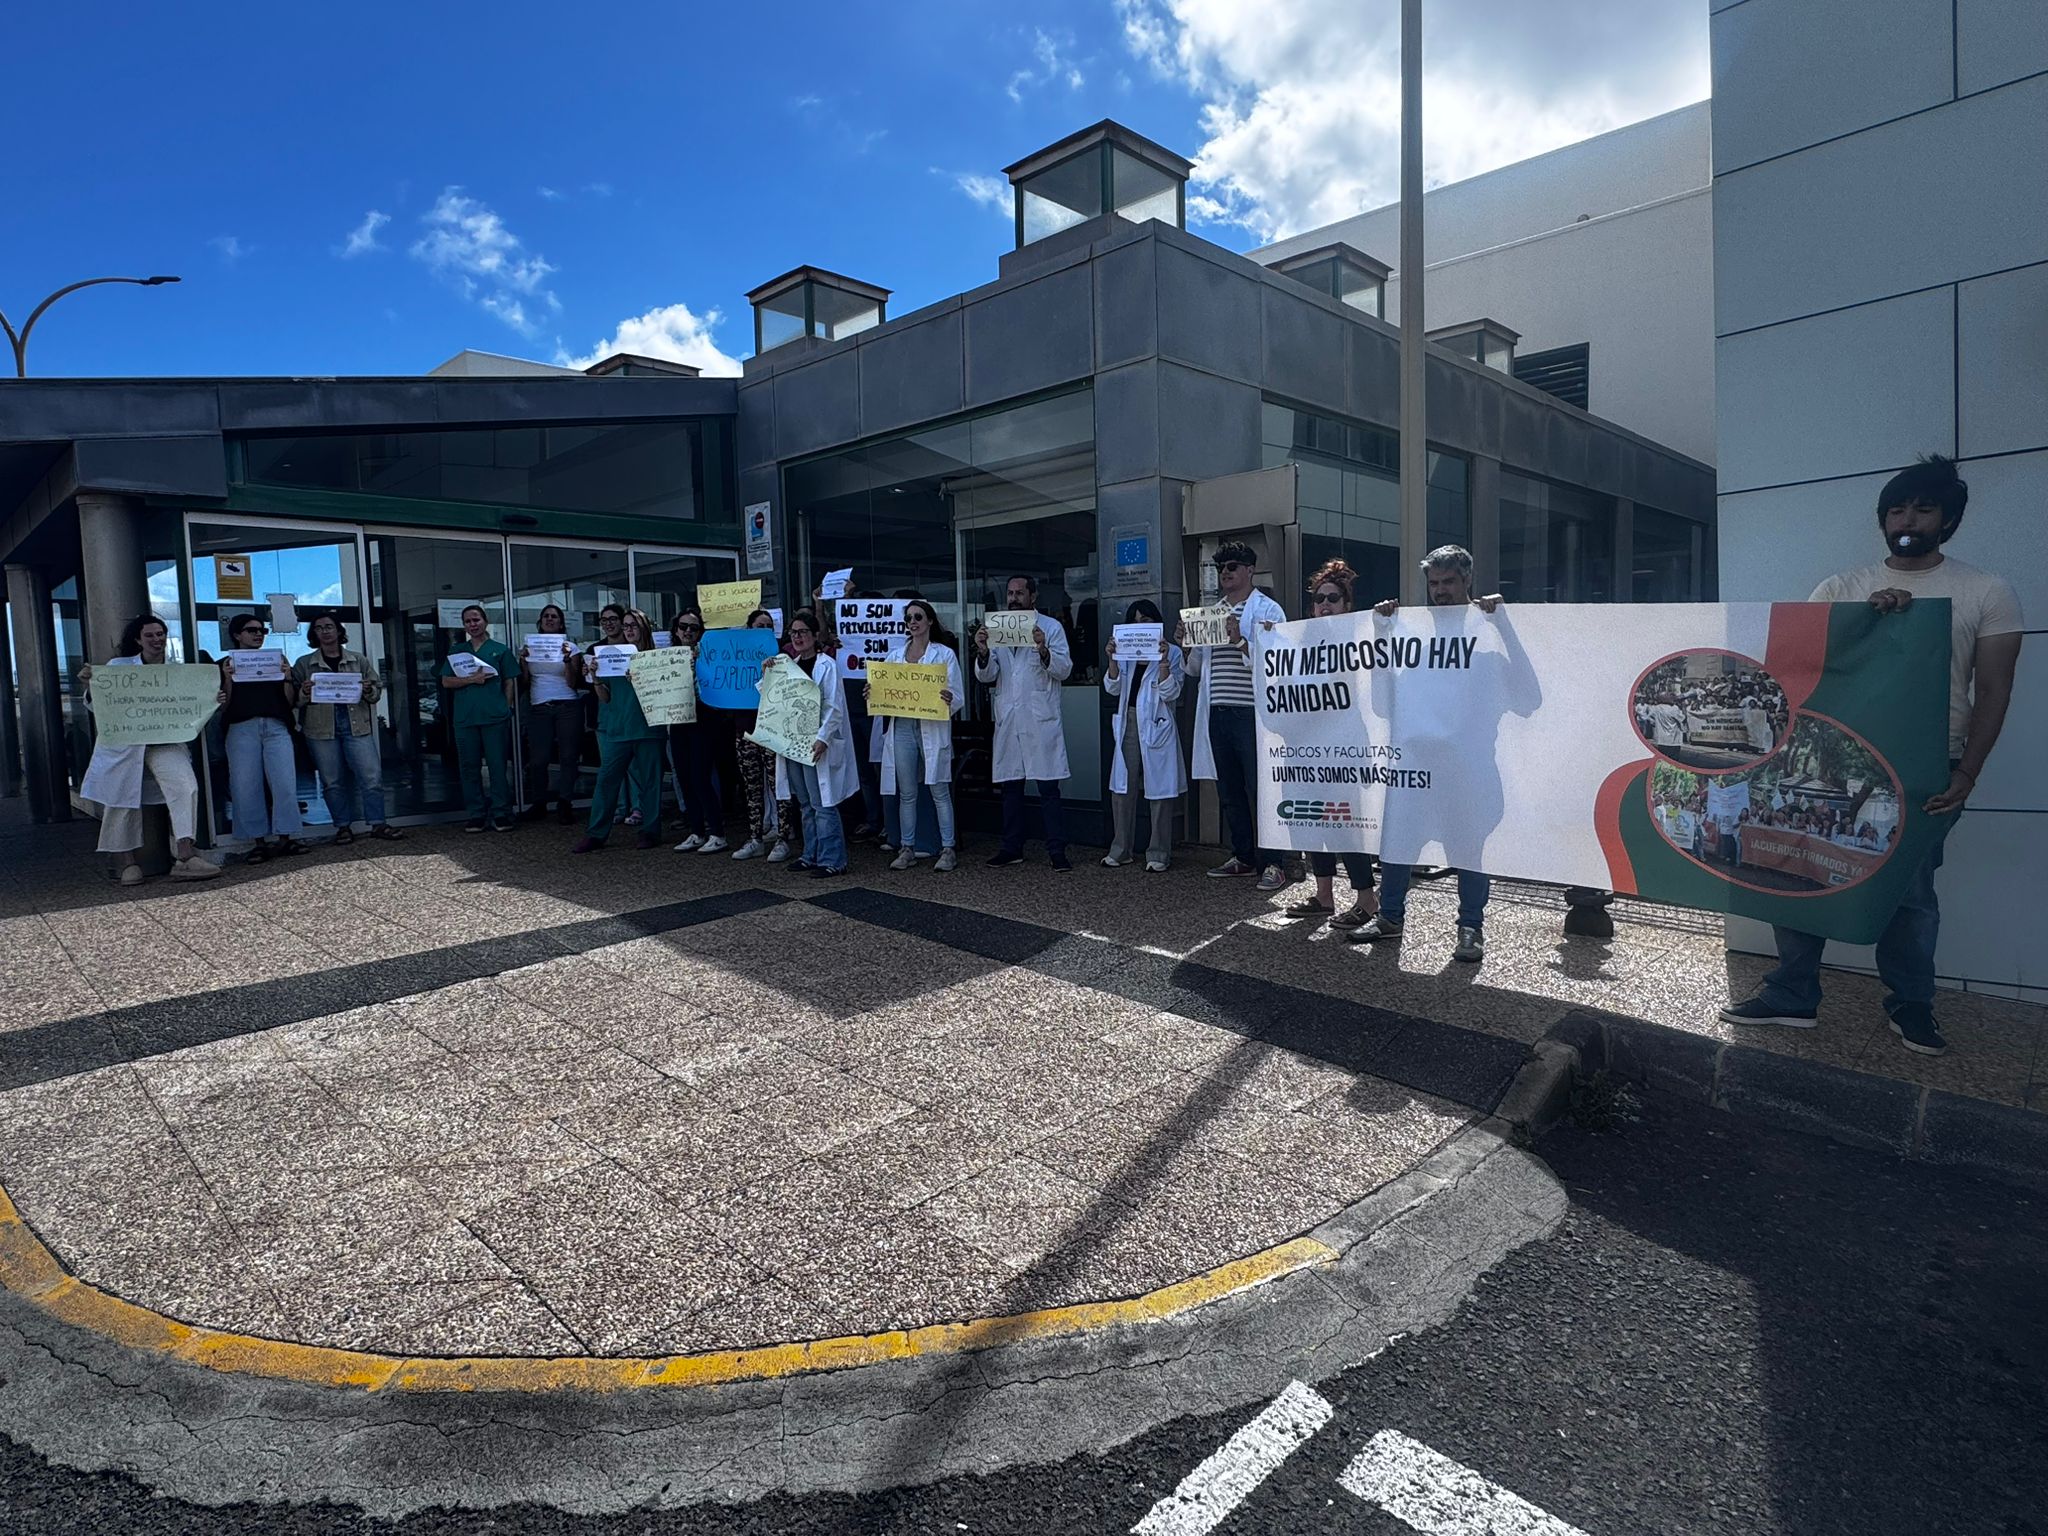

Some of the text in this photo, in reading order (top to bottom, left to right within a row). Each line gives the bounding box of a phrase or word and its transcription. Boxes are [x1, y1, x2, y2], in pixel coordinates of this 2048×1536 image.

[841, 604, 893, 619] NO SON
[1185, 610, 1196, 619] 24
[1211, 607, 1226, 616] NOS
[839, 621, 911, 636] PRIVILEGIO
[991, 614, 1029, 629] STOP
[995, 631, 1028, 644] 24h
[864, 639, 889, 654] SON
[1265, 636, 1477, 677] SIN MÉDICOS NO HAY
[97, 672, 138, 689] STOP
[713, 665, 762, 690] EXPLOTA
[870, 670, 946, 683] POR UN ESTATUTO
[884, 688, 920, 702] PROPIO
[1266, 681, 1351, 713] SANIDAD
[1269, 745, 1321, 759] MÉDICOS
[1321, 746, 1330, 758] Y
[1272, 766, 1316, 783] ¡JUNTOS
[1318, 766, 1358, 784] SOMOS
[1360, 763, 1387, 784] MÁS
[1277, 800, 1352, 822] CESM
[1278, 820, 1313, 828] SINDICATO
[1345, 822, 1378, 830] CANARIO
[1802, 849, 1848, 874] FIRMADOS
